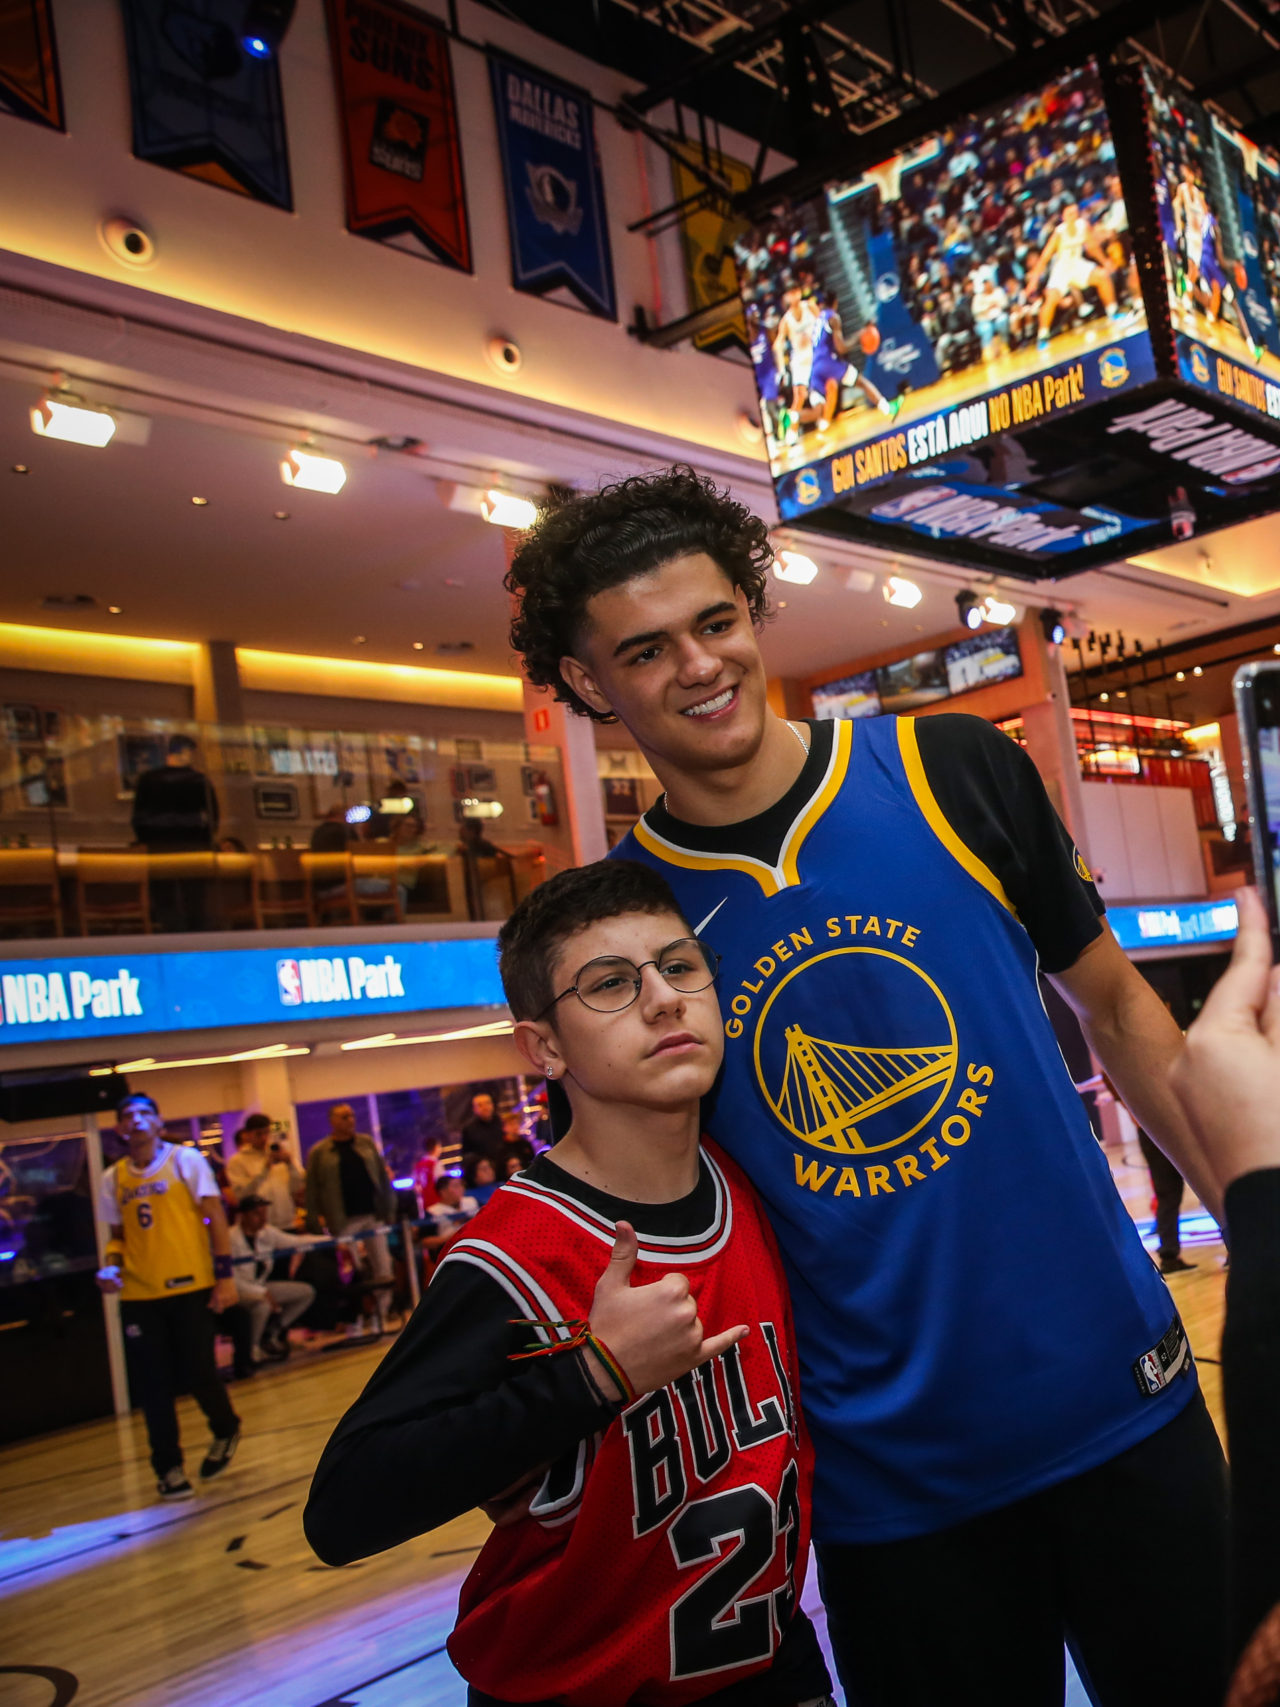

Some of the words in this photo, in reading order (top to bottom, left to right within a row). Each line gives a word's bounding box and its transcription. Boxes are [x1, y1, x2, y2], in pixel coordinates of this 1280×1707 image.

[350, 27, 434, 90] SUNS
[507, 72, 579, 128] DALLAS
[854, 433, 908, 484] SANTOS
[988, 392, 1010, 433] NO
[1011, 379, 1044, 425] NBA
[1043, 362, 1085, 413] Park!
[1105, 398, 1234, 454] Park
[902, 493, 1018, 536] NBA
[1, 971, 71, 1025] NBA
[69, 968, 143, 1020] Park
[300, 957, 352, 1004] NBA
[347, 954, 406, 1000] Park
[724, 927, 814, 1039] GOLDEN
[825, 915, 922, 948] STATE
[793, 1062, 994, 1198] WARRIORS
[136, 1203, 154, 1230] 6
[621, 1321, 799, 1540] BULL
